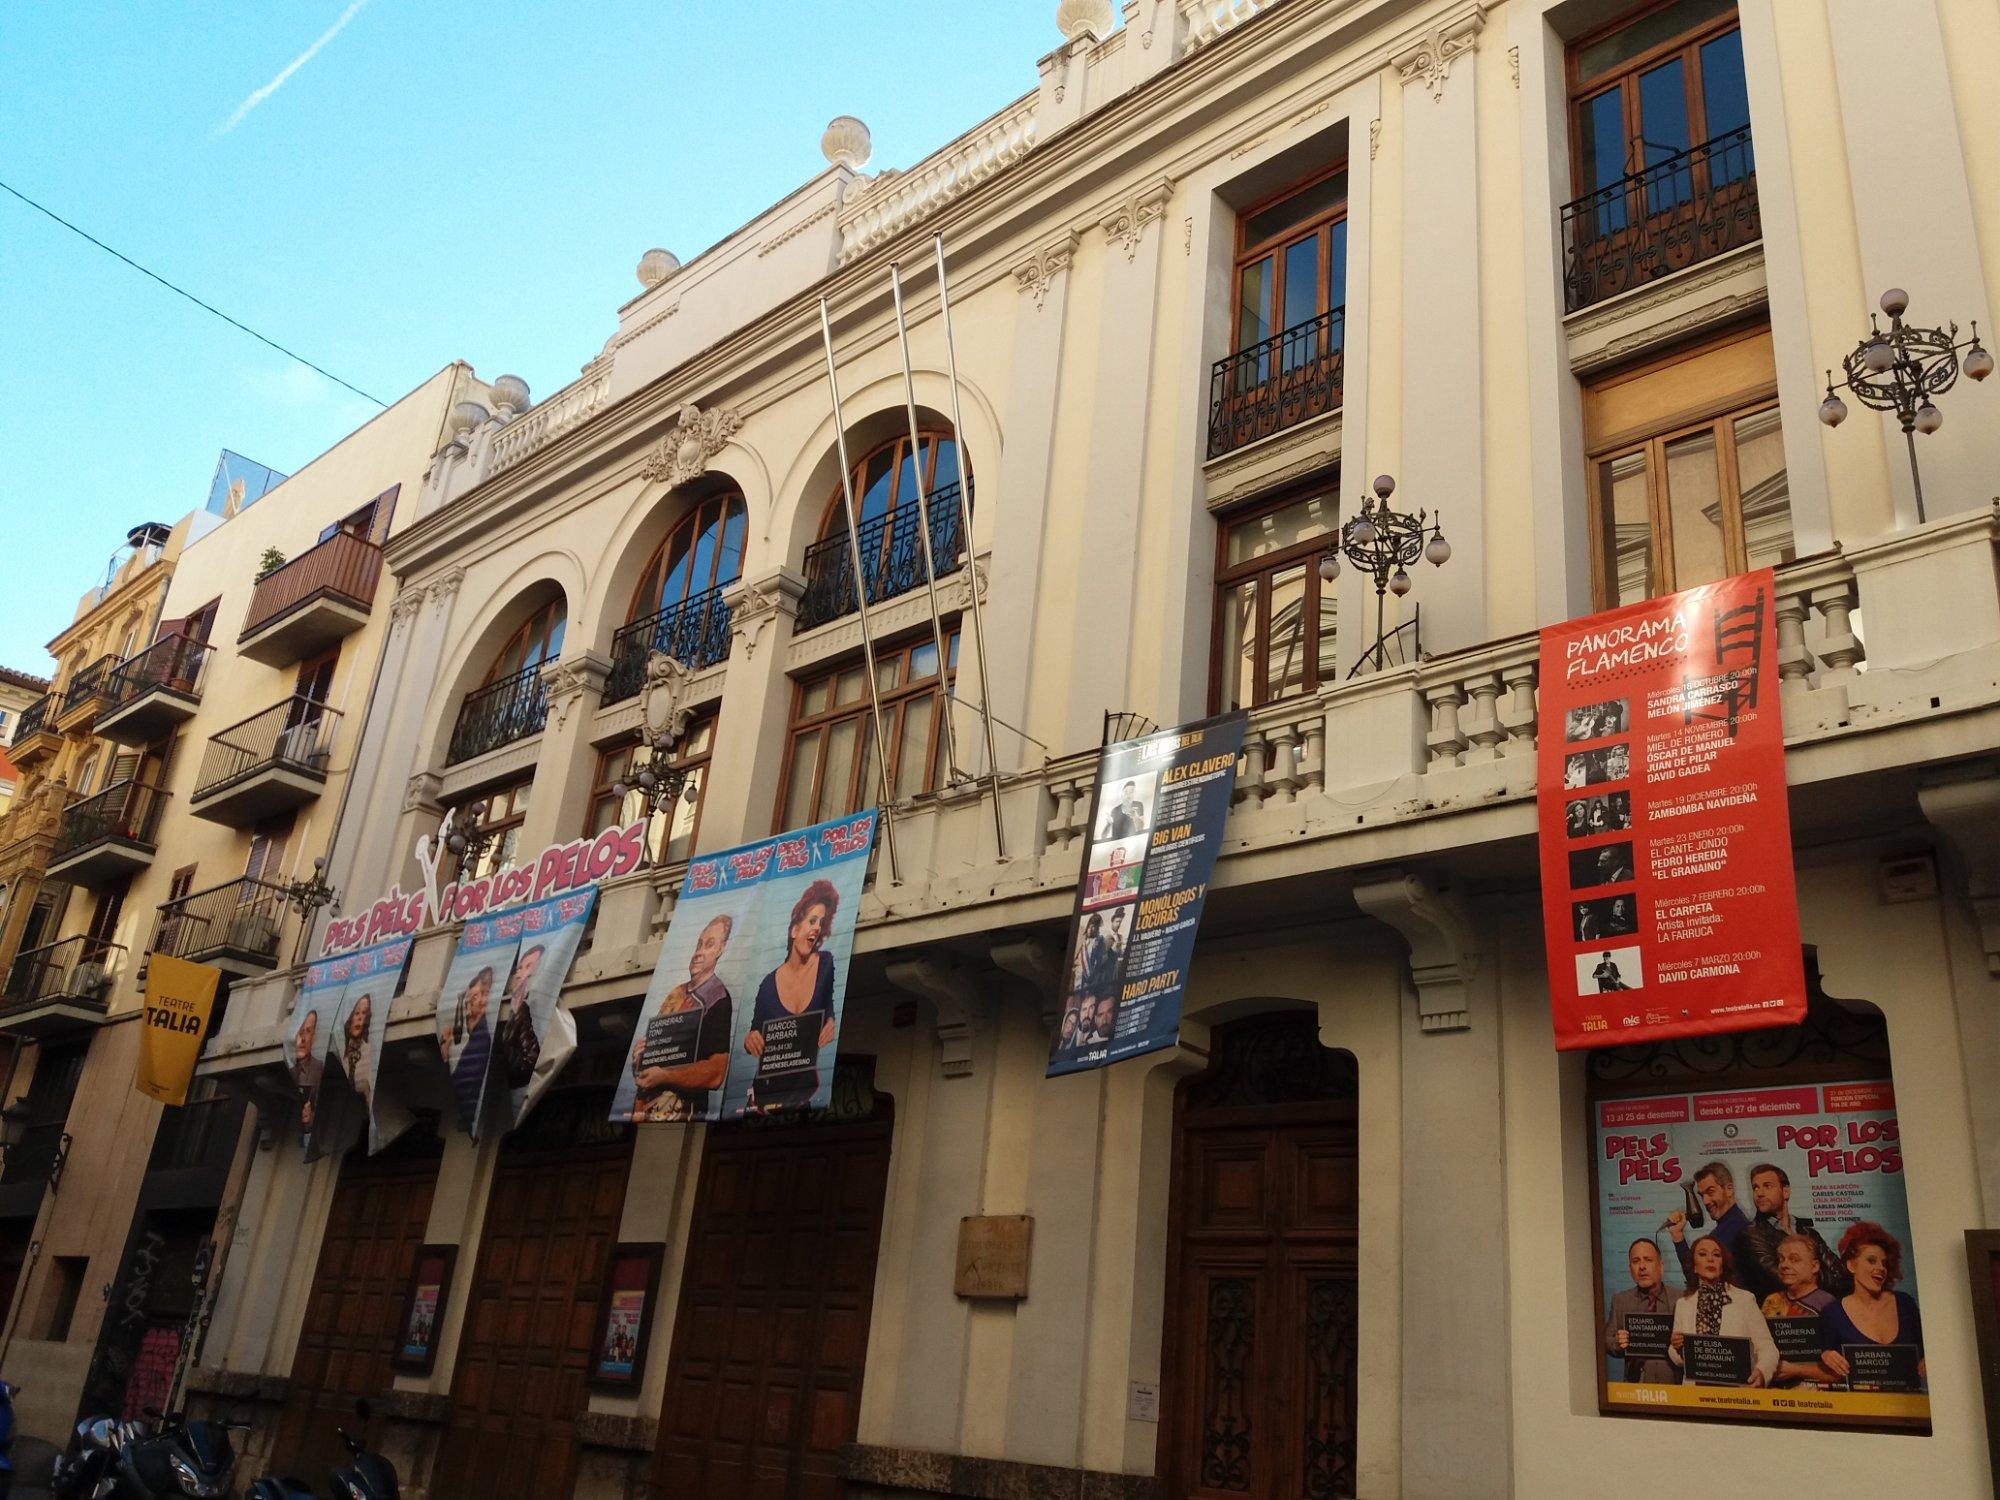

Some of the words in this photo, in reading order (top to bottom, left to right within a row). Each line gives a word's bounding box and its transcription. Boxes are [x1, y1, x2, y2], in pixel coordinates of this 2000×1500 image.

[1567, 611, 1687, 659] PANORAMA
[1567, 633, 1689, 680] FLAMENCO
[1683, 682, 1693, 691] 18
[1693, 674, 1728, 689] OCTUBRE
[1730, 667, 1758, 680] 20:00h
[1647, 694, 1686, 709] SANDRA
[1687, 681, 1738, 699] CARRASCO
[1647, 704, 1680, 719] MELÓN
[1682, 694, 1723, 711] JIMÉNEZ
[1647, 733, 1671, 744] Martes
[1674, 730, 1683, 738] 14
[1684, 719, 1728, 734] NOVIEMBRE
[1730, 713, 1758, 725] 20:00h
[1647, 742, 1669, 753] MIEL
[1670, 739, 1682, 748] DE
[1684, 729, 1724, 745] ROMERO
[1647, 748, 1678, 763] ÓSCAR
[1681, 745, 1693, 755] DE
[1696, 737, 1736, 751] MANUEL
[1189, 752, 1236, 778] CLAVERO
[1647, 761, 1671, 773] JUAN
[1674, 758, 1687, 768] DE
[1689, 751, 1717, 765] PILAR
[1647, 770, 1675, 784] DAVID
[1678, 763, 1711, 777] GADEA
[1648, 799, 1672, 810] Martes
[1675, 796, 1684, 804] 19
[1686, 788, 1728, 802] DICIEMBRE
[1730, 782, 1758, 795] 20:00h
[1648, 802, 1705, 821] ZAMBOMBA
[1706, 793, 1758, 809] NAVIDEÑA
[1152, 829, 1169, 847] BIG
[1171, 823, 1192, 842] VAN
[1649, 838, 1674, 848] Martes
[1676, 834, 1687, 843] 23
[1688, 829, 1714, 841] ENERO
[1716, 824, 1744, 836] 20:00h
[1650, 848, 1662, 859] EL
[1664, 843, 1694, 856] CANTE
[1696, 837, 1728, 851] JONDO
[1651, 857, 1683, 870] PEDRO
[1685, 849, 1728, 864] HEREDIA
[1652, 869, 1669, 880] "EL
[321, 912, 368, 954] PELS
[438, 880, 489, 922] POR
[491, 865, 536, 905] LOS
[533, 821, 647, 901] PELOS
[1654, 896, 1690, 908] Miércoles
[1692, 894, 1697, 903] 7
[1699, 888, 1735, 902] FEBRERO
[1736, 884, 1766, 896] 20:00h
[1138, 888, 1197, 916] MONÓLOGOS
[1198, 884, 1206, 899] Y
[1655, 910, 1667, 920] EL
[1669, 903, 1713, 918] CARPETA
[1135, 908, 1180, 931] LOCURAS
[1657, 919, 1684, 931] Artista
[1687, 913, 1724, 927] invitada:
[1657, 933, 1670, 943] LA
[1671, 926, 1713, 941] FARRUCA
[1657, 960, 1692, 972] Miércoles
[1694, 958, 1699, 966] 7
[1701, 953, 1730, 966] MARZO
[1732, 950, 1761, 962] 20:00h
[1122, 980, 1148, 1000] HARD
[1148, 969, 1179, 993] PARTY
[1658, 971, 1688, 984] DAVID
[1690, 964, 1741, 980] CARMONA
[159, 995, 197, 1013] TEATRE
[146, 1007, 202, 1035] TALIA
[1582, 1020, 1608, 1032] TALIA
[1089, 1049, 1107, 1061] TALIA
[1606, 1113, 1615, 1123] 13
[1616, 1112, 1624, 1122] al
[1625, 1112, 1635, 1121] 25
[1636, 1111, 1645, 1120] de
[1647, 1109, 1684, 1120] desembre
[1699, 1105, 1724, 1116] desde
[1725, 1105, 1733, 1115] el
[1735, 1104, 1744, 1114] 27
[1746, 1103, 1757, 1113] de
[1759, 1100, 1801, 1112] diciembre
[1776, 1124, 1839, 1150] POR
[1846, 1118, 1899, 1146] LOS
[1605, 1133, 1669, 1160] PELS
[1808, 1146, 1903, 1178] PELOS
[1628, 1317, 1654, 1325] EDUARD
[1856, 1358, 1890, 1366] MARCOS
[1635, 1389, 1668, 1403] TALIA
[1797, 1400, 1834, 1409] teatretalia
